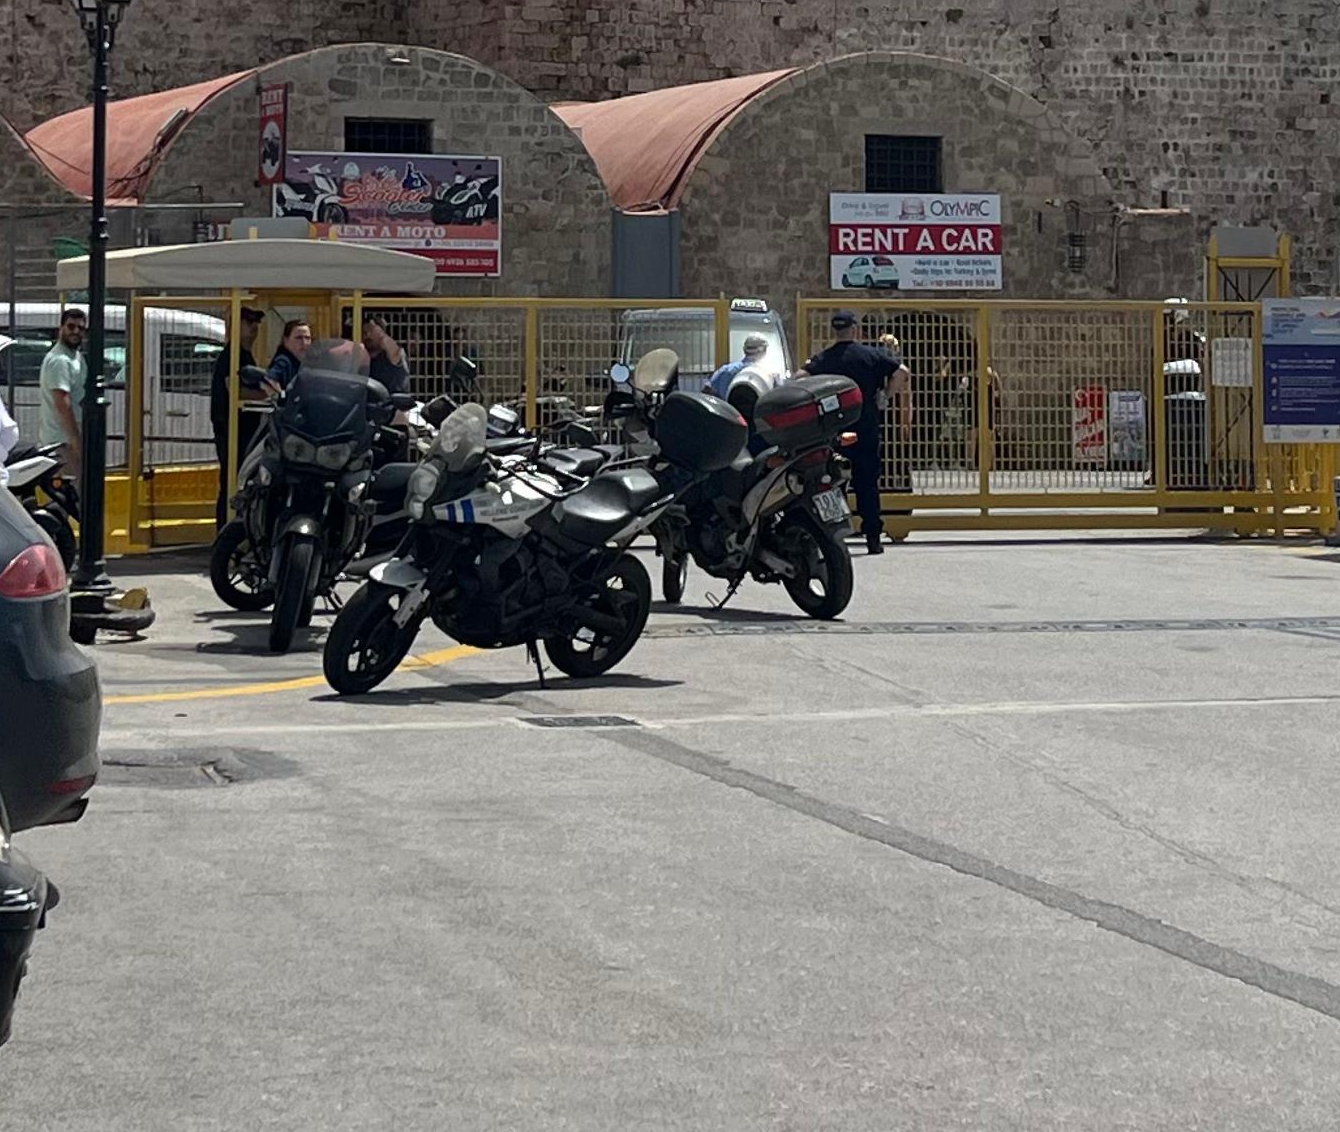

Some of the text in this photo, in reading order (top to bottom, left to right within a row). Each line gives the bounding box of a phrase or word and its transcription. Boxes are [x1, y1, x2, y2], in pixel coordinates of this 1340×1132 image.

[465, 203, 487, 219] ATV
[930, 200, 990, 216] OLYMPIC
[334, 225, 446, 238] RENT A MOTO
[838, 228, 994, 251] RENT A CAR
